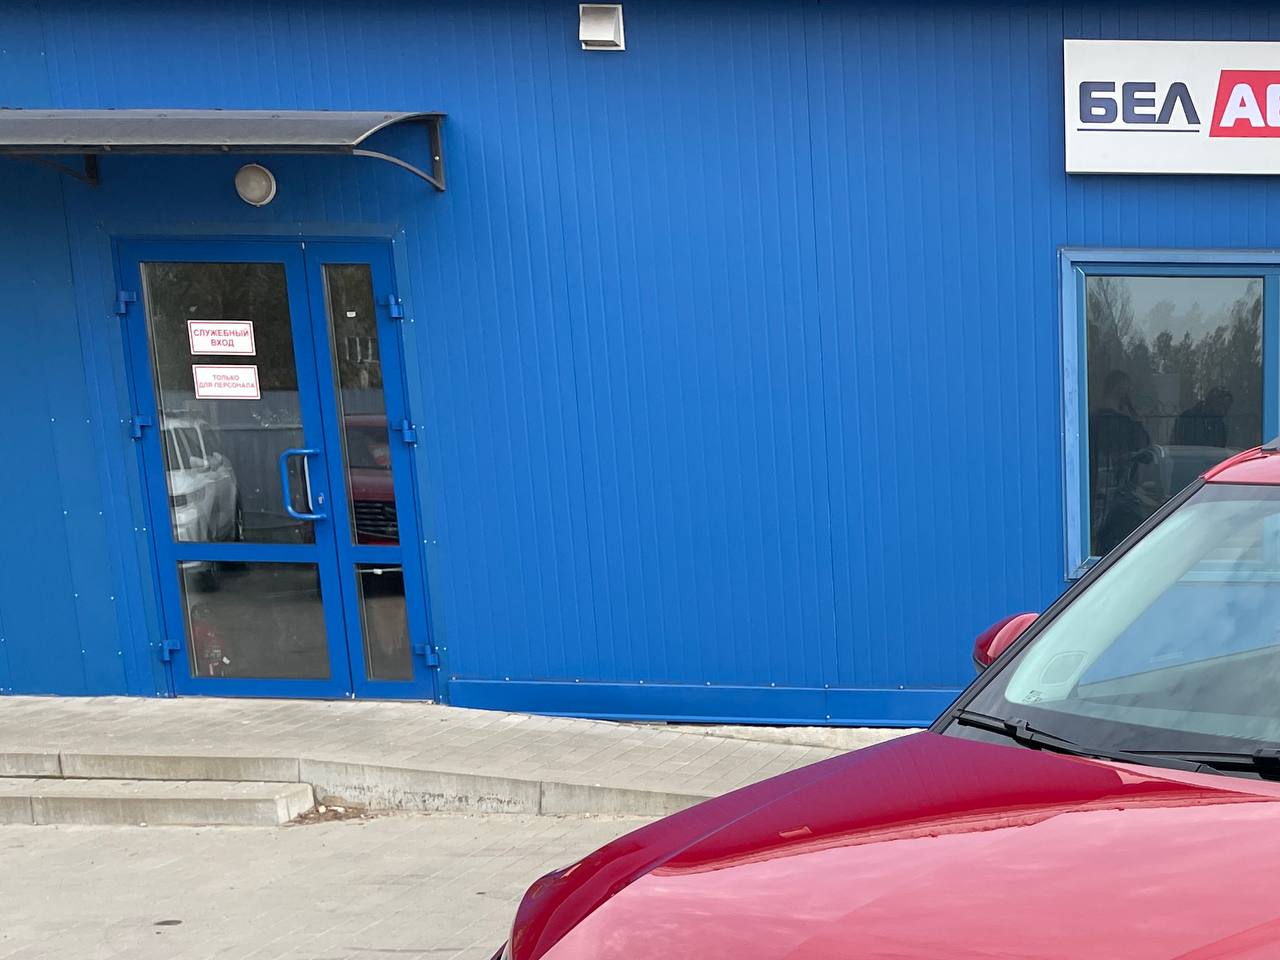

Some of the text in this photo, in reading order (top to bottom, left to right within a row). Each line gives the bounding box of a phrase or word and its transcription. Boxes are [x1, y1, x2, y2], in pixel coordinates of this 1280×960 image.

[1078, 81, 1201, 125] БЕЛ
[193, 328, 249, 337] СЛУЖЕБНЫЙ
[210, 339, 235, 347] ВХОД
